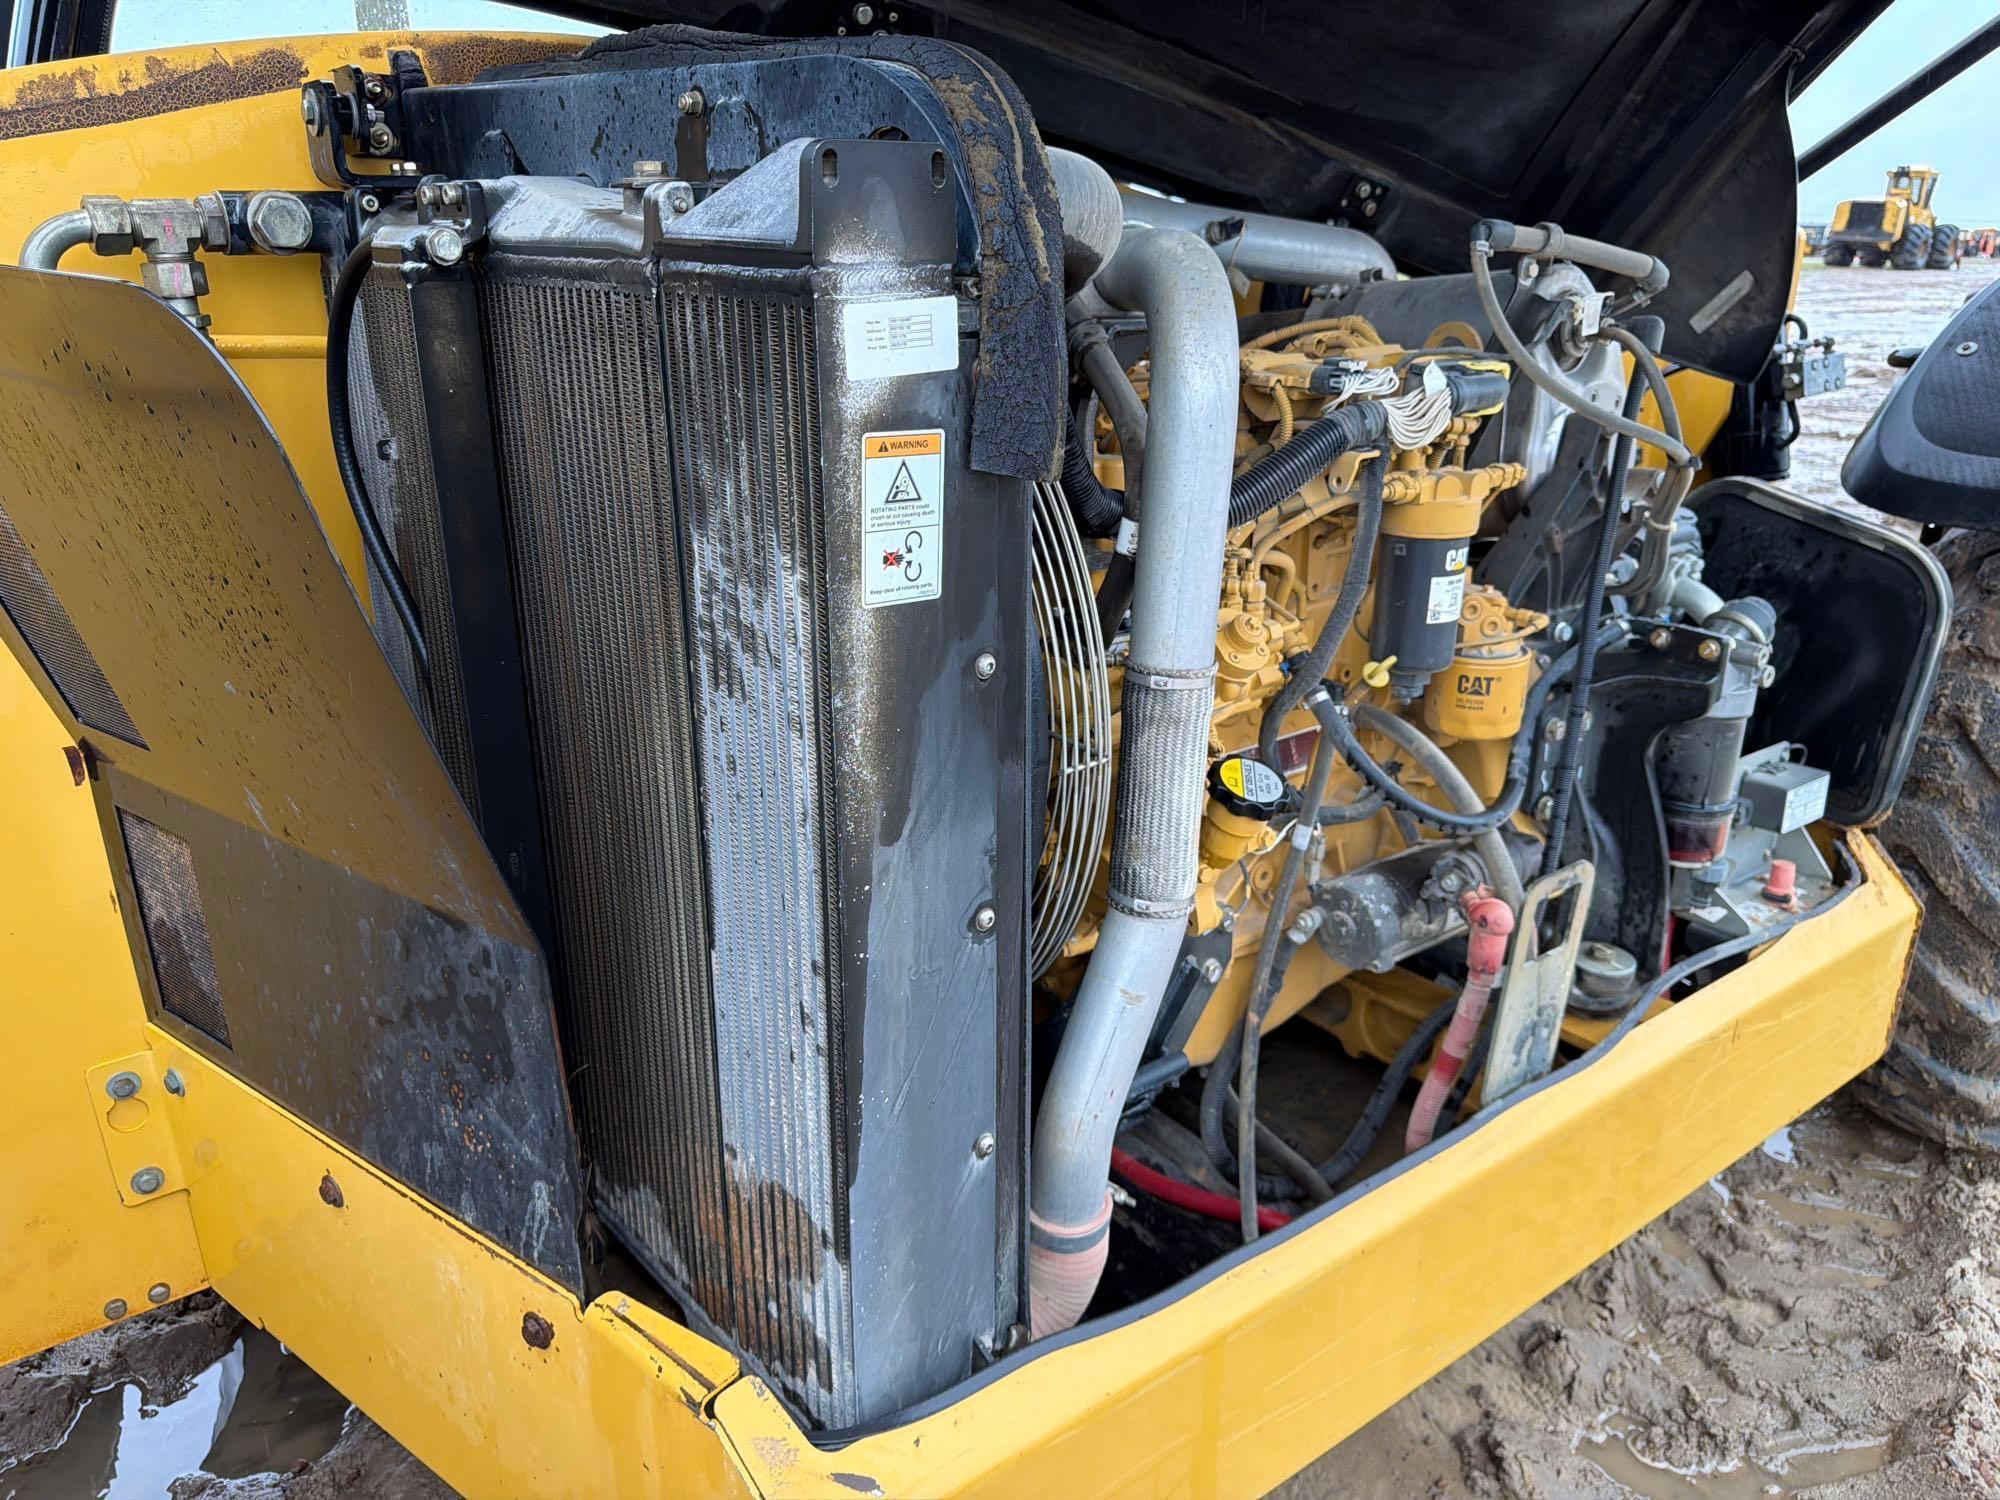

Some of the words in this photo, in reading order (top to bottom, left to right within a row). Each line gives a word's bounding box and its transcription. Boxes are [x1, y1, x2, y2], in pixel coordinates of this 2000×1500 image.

[890, 440, 929, 450] WARNING
[870, 506, 897, 514] ROTATING
[1445, 546, 1469, 572] CAT
[1457, 674, 1495, 697] CAT
